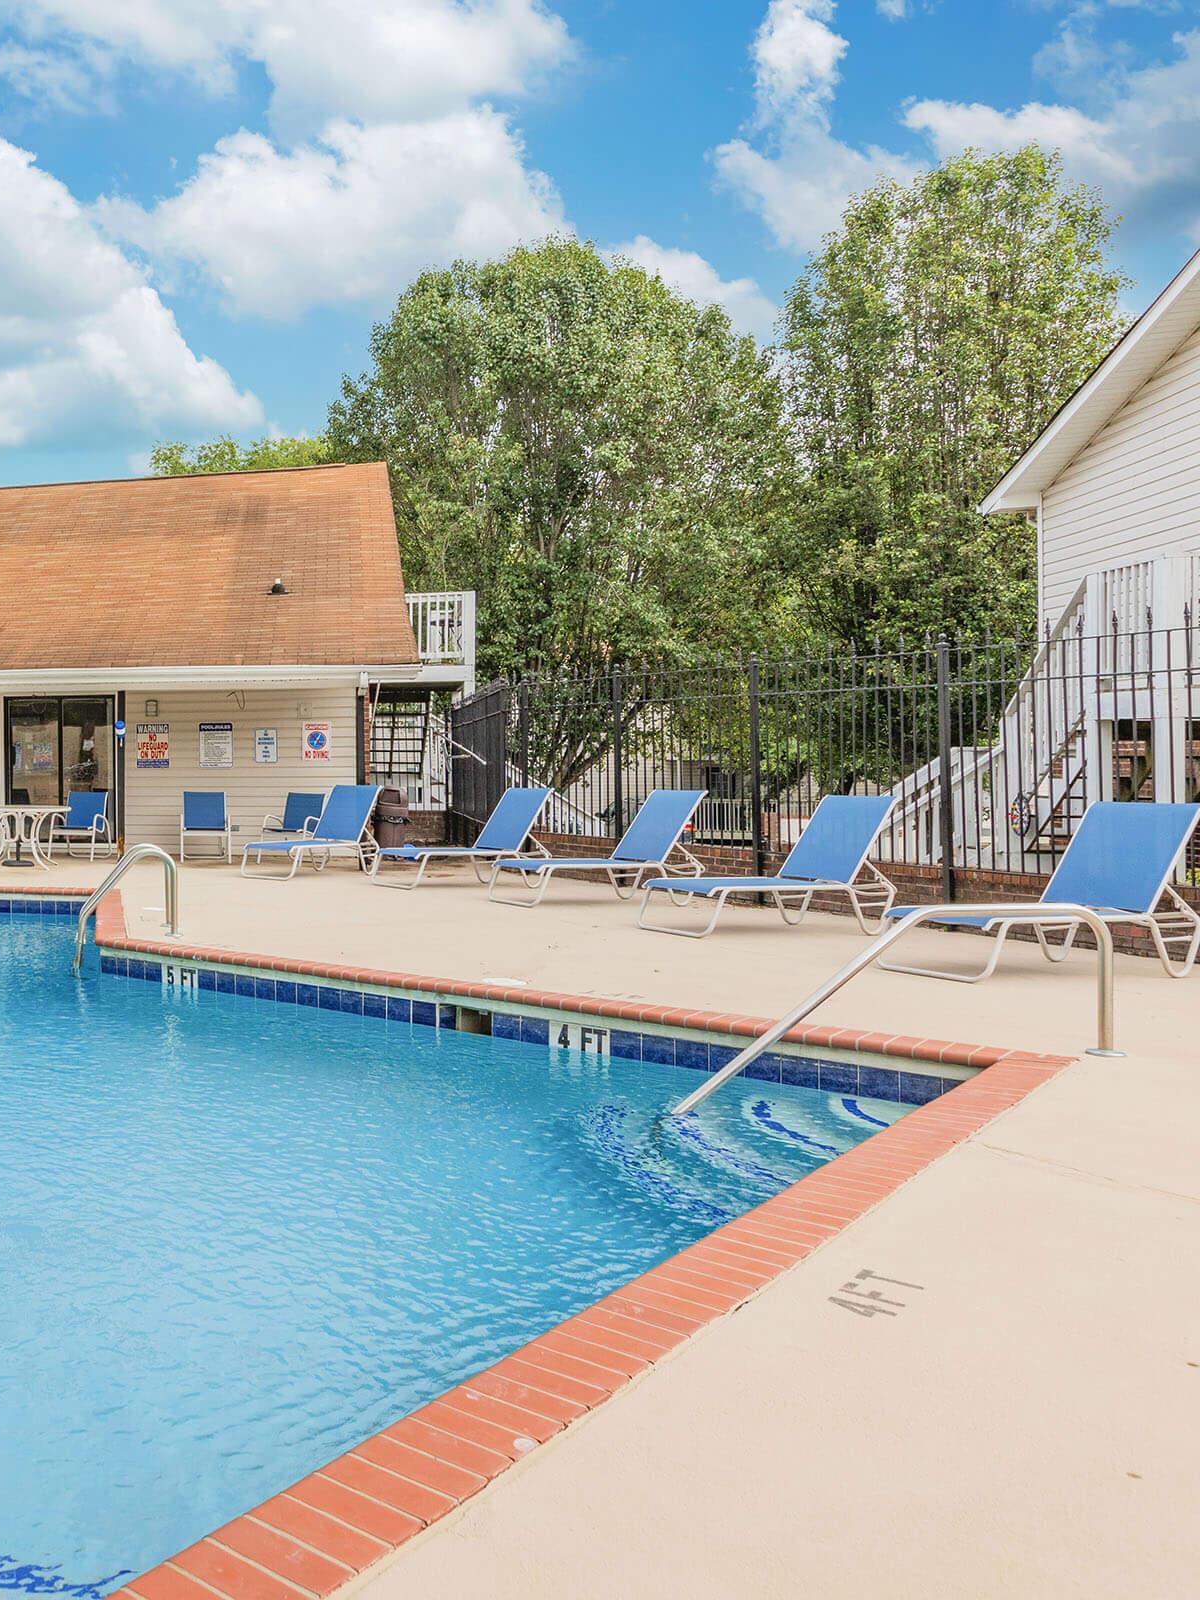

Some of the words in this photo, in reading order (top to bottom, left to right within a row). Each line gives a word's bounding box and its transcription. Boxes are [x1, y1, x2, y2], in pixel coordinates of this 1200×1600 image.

[137, 724, 168, 733] WARNING
[137, 742, 168, 750] LIFEGUARD
[140, 750, 148, 758] ON
[151, 750, 165, 758] DUTY
[167, 966, 174, 985] 5
[180, 968, 196, 988] FT
[558, 1024, 570, 1048] 4
[581, 1027, 607, 1053] FT
